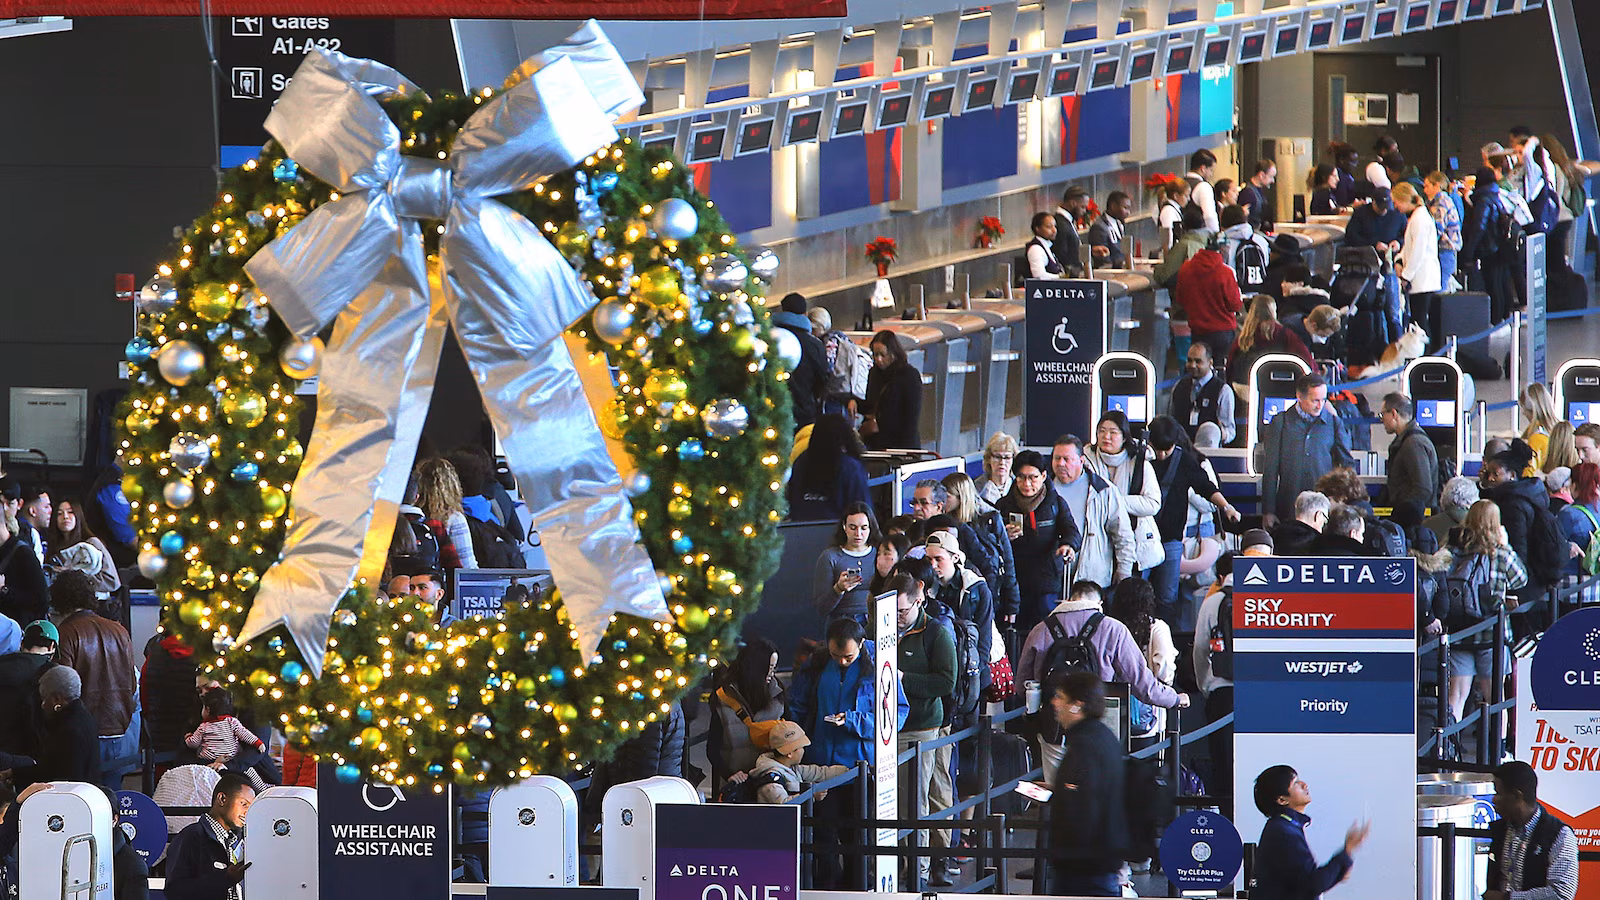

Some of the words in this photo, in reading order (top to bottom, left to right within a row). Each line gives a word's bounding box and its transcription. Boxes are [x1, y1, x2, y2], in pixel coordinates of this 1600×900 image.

[272, 17, 329, 29] Gates
[1045, 289, 1085, 299] DELTA
[1277, 564, 1375, 583] DELTA
[463, 596, 487, 608] TSA
[489, 596, 502, 608] IS
[1244, 598, 1283, 612] SKY
[1244, 613, 1335, 627] PRIORITY
[1285, 661, 1347, 677] WESTJET
[1300, 699, 1348, 714] Priority
[1574, 725, 1593, 735] TSA
[1530, 746, 1559, 771] TO
[331, 824, 437, 839] WHEELCHAIR
[1577, 837, 1592, 846] KIP
[334, 841, 434, 856] ASSISTANCE
[687, 865, 739, 876] DELTA
[1177, 868, 1187, 876] Try
[1210, 869, 1224, 877] Plus
[96, 883, 109, 892] CLEAR
